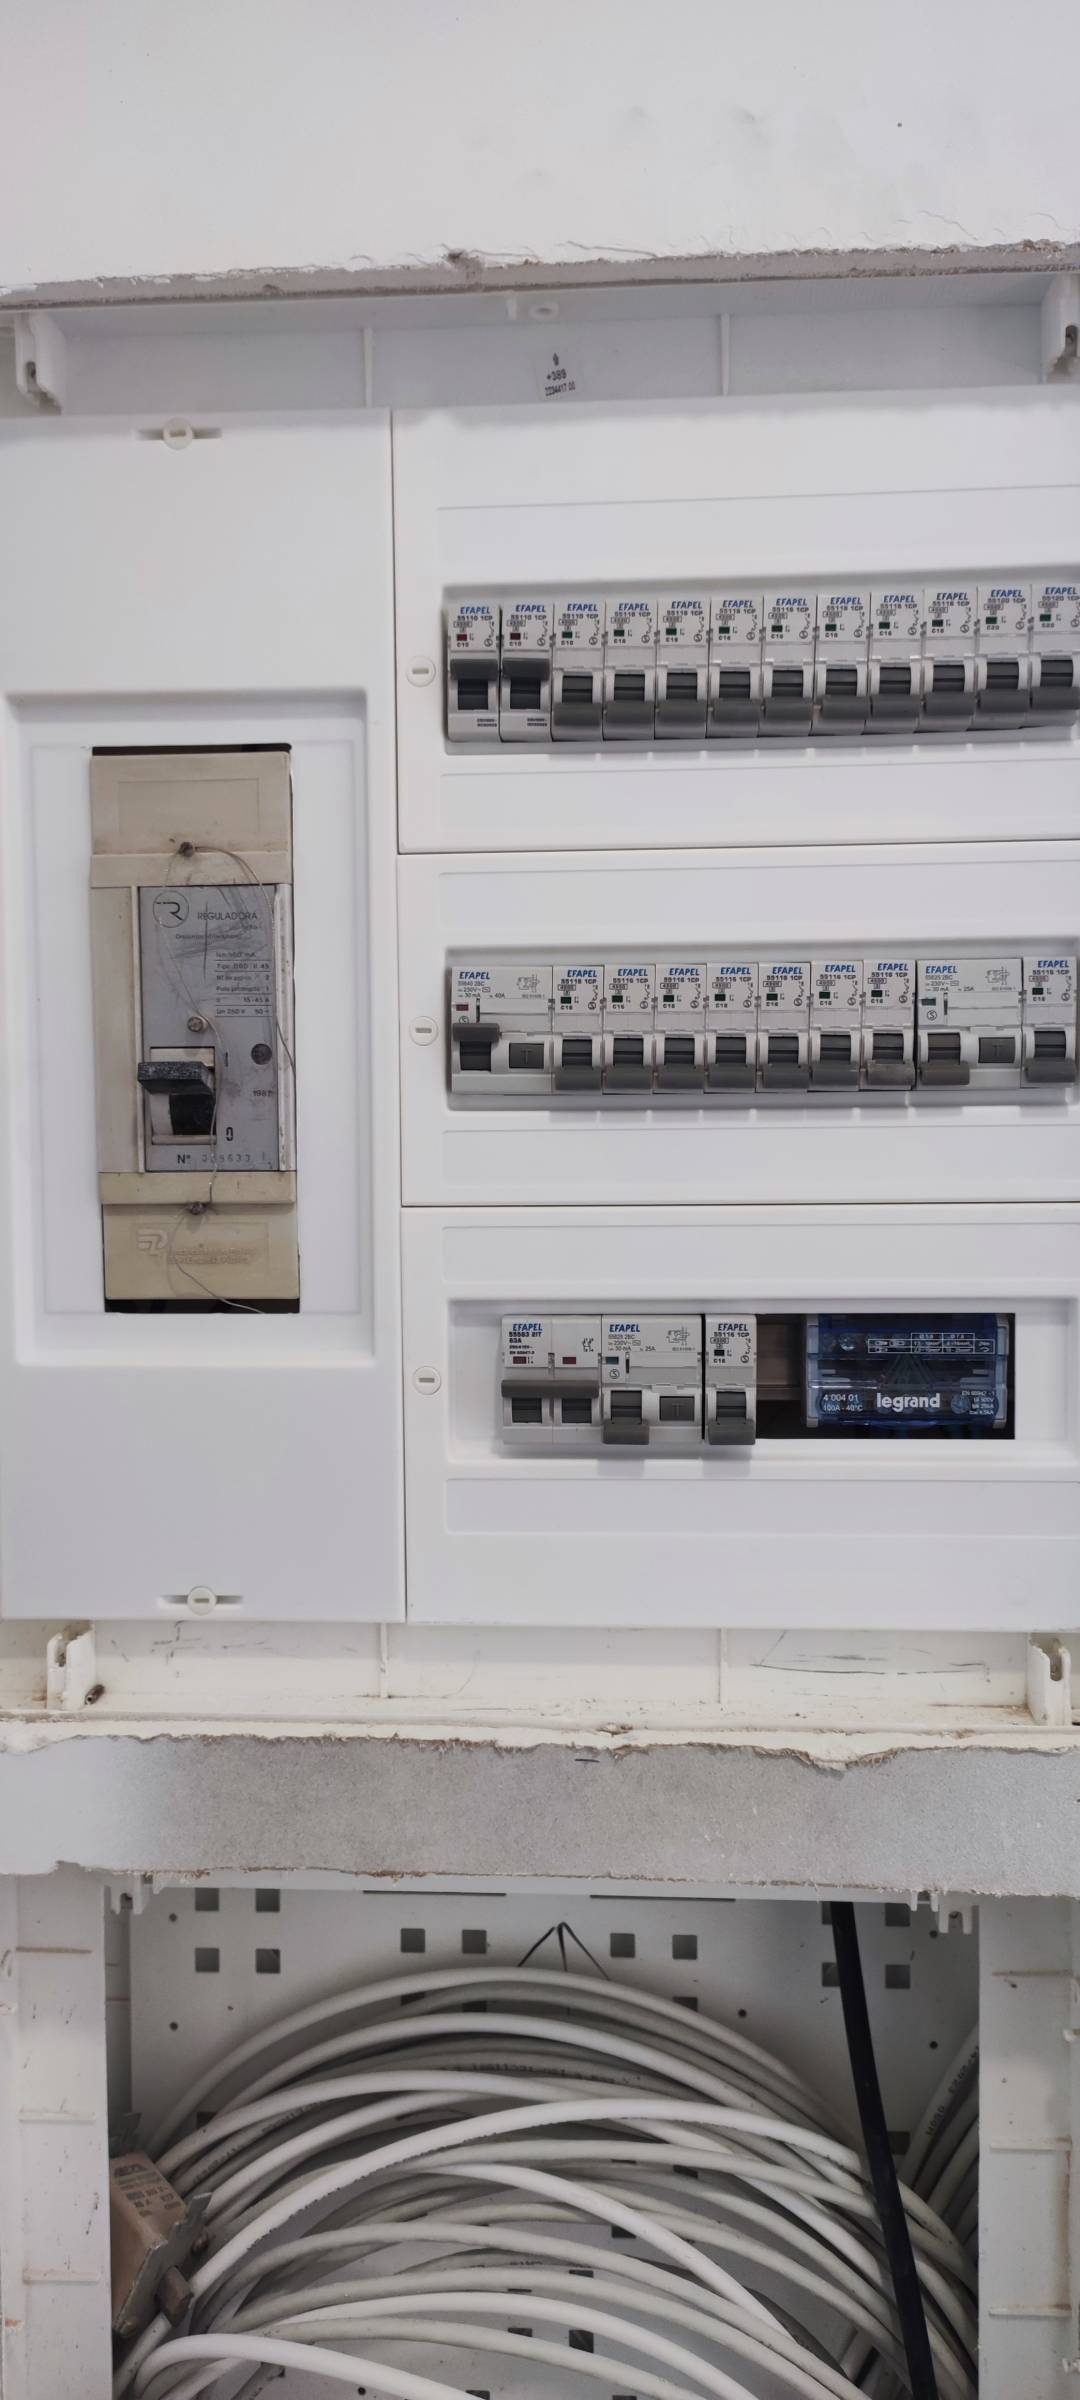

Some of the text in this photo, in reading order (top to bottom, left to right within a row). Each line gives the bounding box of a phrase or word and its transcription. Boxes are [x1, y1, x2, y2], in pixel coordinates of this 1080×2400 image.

[991, 589, 1022, 597] EFAPEL
[1045, 587, 1077, 595] EFAPEL
[884, 595, 915, 603] EFAPEL
[936, 592, 968, 600] EFAPEL
[671, 601, 702, 609] EFAPEL
[723, 600, 753, 608] EFAPEL
[776, 598, 807, 606] EFAPEL
[830, 597, 861, 605] EFAPEL
[460, 606, 490, 614] EFAPEL
[515, 604, 545, 612] EFAPEL
[567, 603, 598, 611] EFAPEL
[619, 603, 649, 611] EFAPEL
[198, 912, 258, 921] REGULADORA
[825, 964, 856, 972] EFAPEL
[877, 963, 908, 971] EFAPEL
[1038, 960, 1069, 968] EFAPEL
[567, 970, 597, 978] EFAPEL
[669, 968, 700, 976] EFAPEL
[720, 967, 751, 975] EFAPEL
[926, 966, 958, 974] EFAPEL
[459, 972, 490, 980] EFAPEL
[512, 1323, 543, 1331] EFAPEL
[609, 1324, 640, 1332] EFAPEL
[718, 1323, 748, 1331] EFAPEL
[848, 1394, 859, 1402] 01
[877, 1392, 940, 1412] legrand
